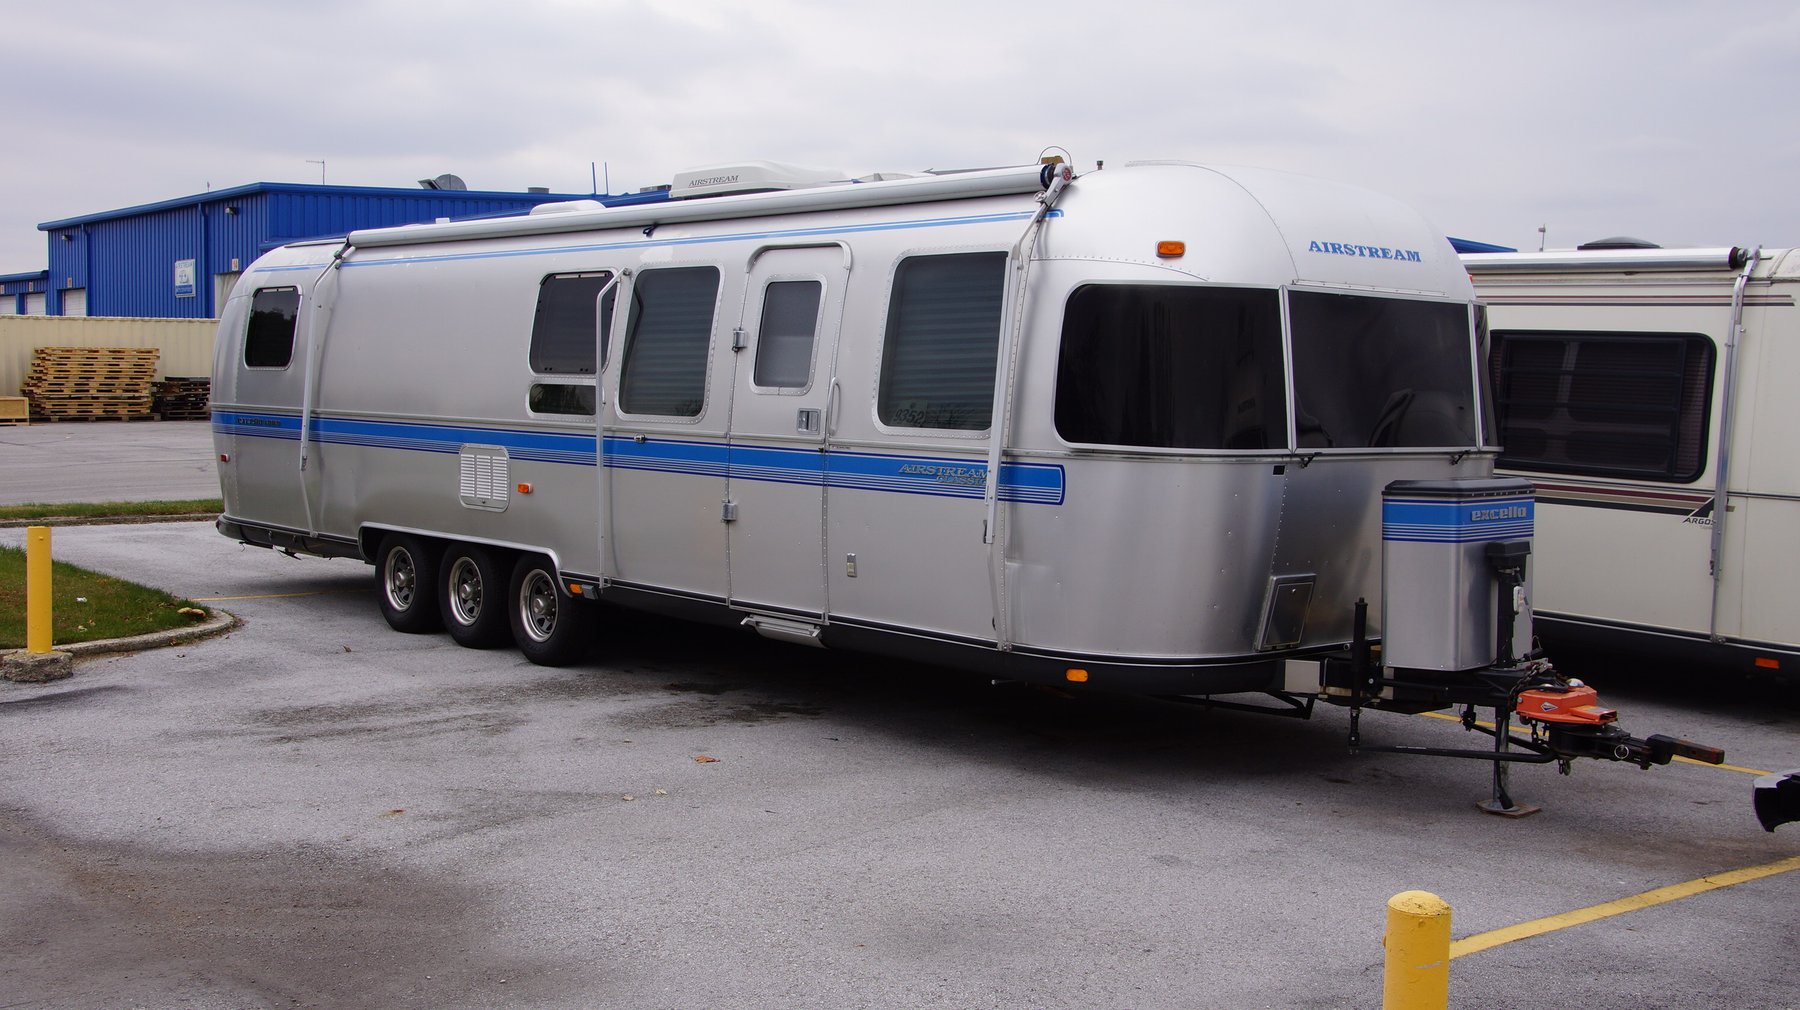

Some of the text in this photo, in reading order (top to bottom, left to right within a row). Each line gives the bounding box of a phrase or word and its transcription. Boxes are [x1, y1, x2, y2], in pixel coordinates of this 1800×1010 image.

[688, 175, 740, 187] AIRSTREAM
[1308, 240, 1422, 262] AIRSTREAM
[898, 463, 988, 479] AIRSTREAM
[1471, 506, 1527, 521] excella
